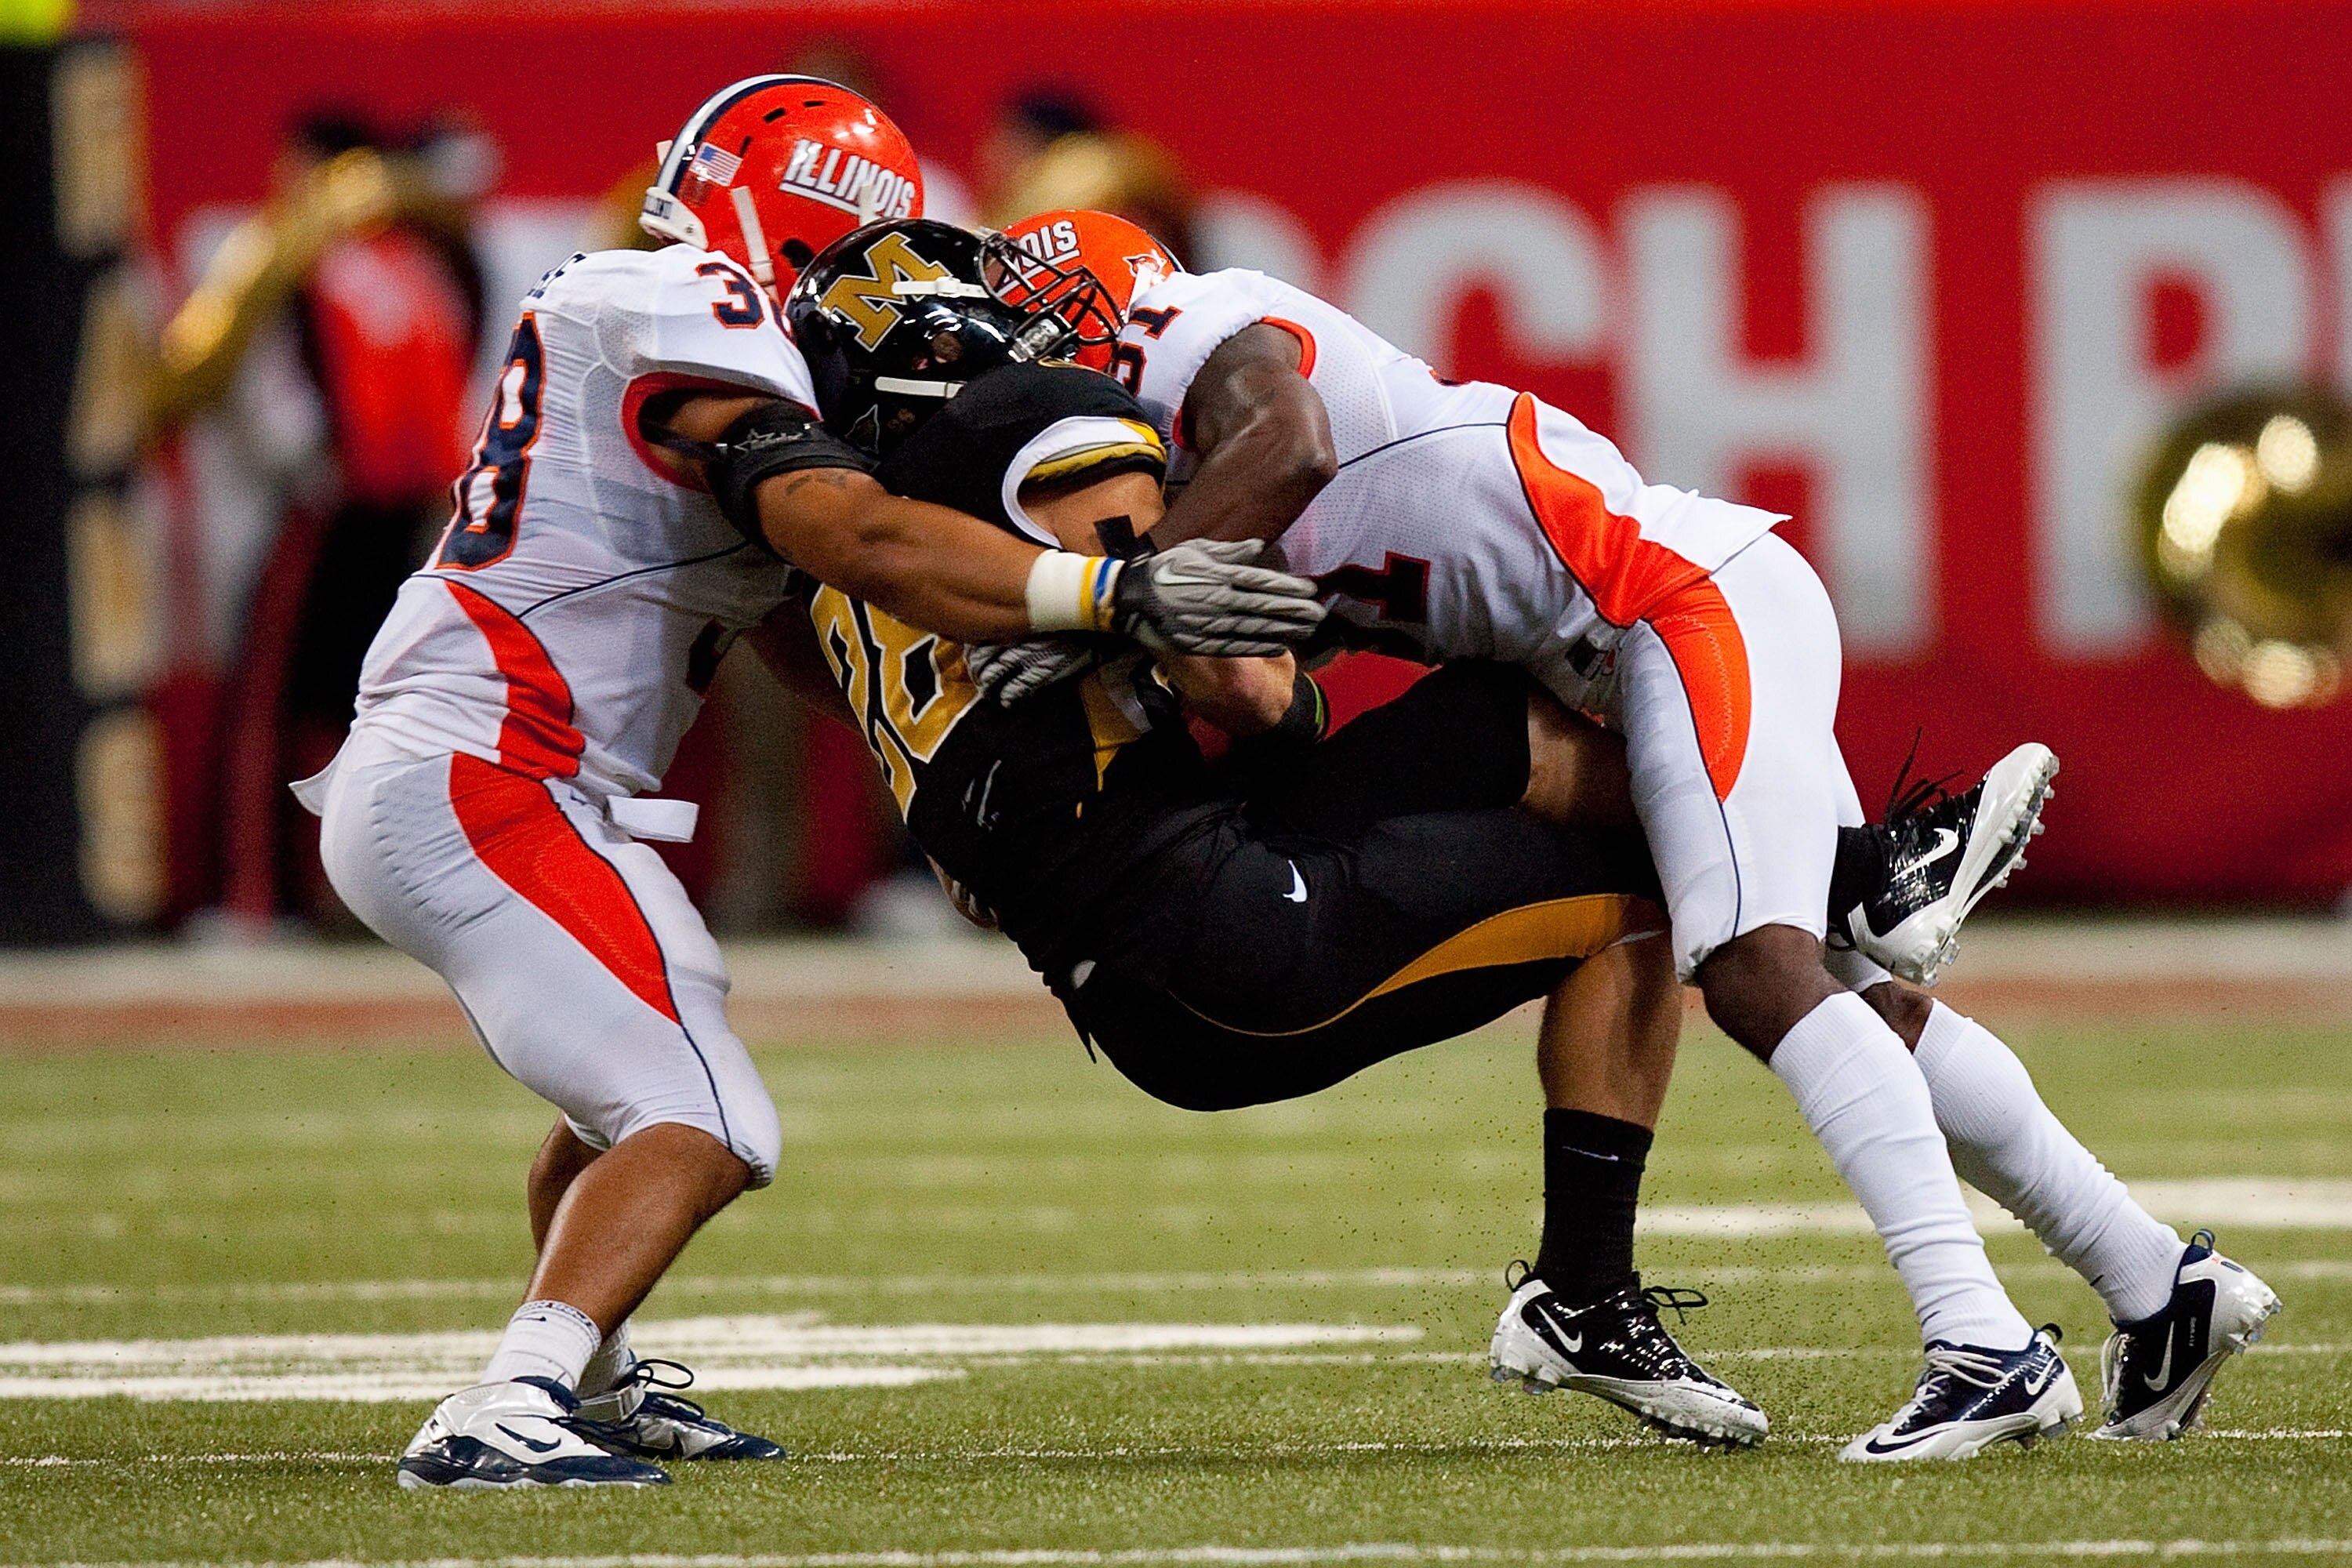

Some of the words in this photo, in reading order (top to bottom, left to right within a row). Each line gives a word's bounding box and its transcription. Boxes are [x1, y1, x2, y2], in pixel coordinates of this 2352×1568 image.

[783, 138, 916, 218] ILLINOIS
[695, 261, 796, 345] 3
[815, 230, 954, 352] M
